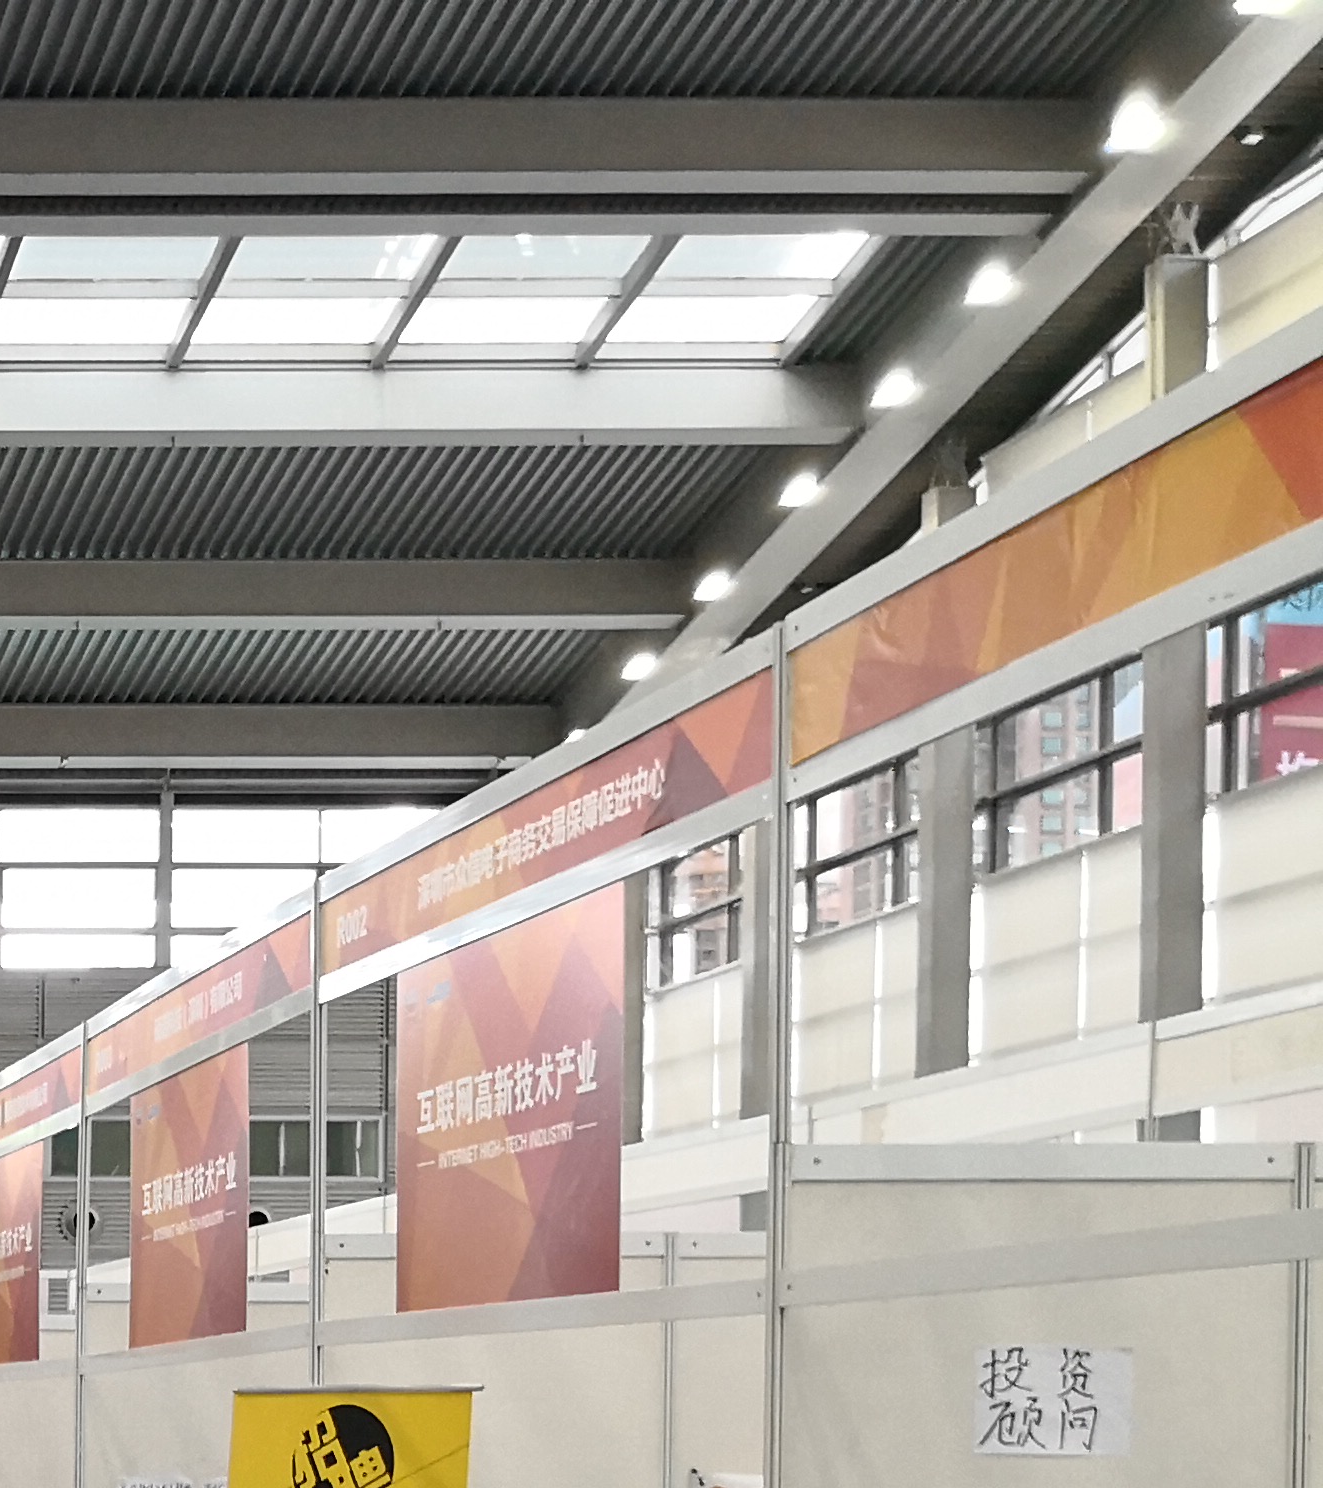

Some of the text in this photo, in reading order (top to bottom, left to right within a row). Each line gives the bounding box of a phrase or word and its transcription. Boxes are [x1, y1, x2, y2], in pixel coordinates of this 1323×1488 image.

[416, 1037, 599, 1135] 互联网高新技术产业
[141, 1150, 237, 1216] 互联网高新技术产业
[978, 1345, 1095, 1400] 投资
[978, 1396, 1098, 1452] 顾问
